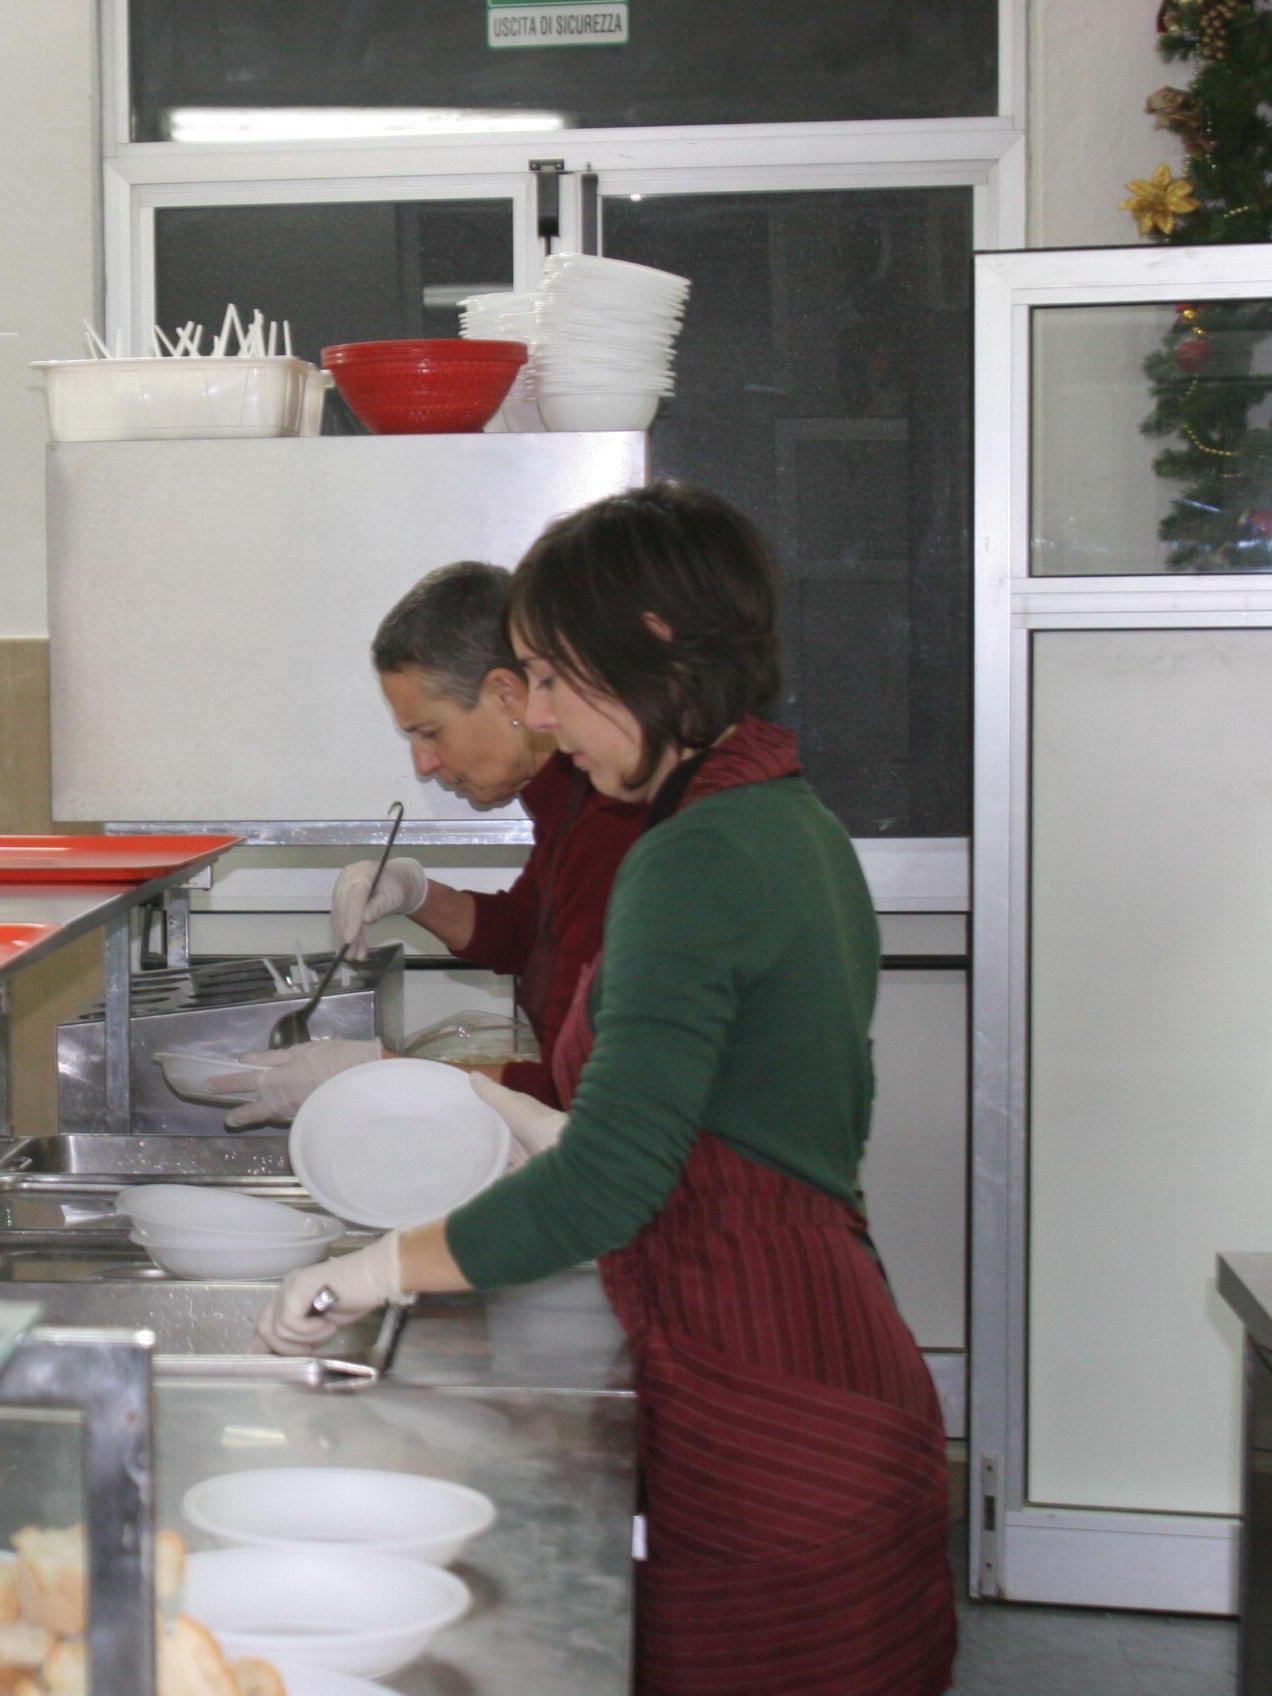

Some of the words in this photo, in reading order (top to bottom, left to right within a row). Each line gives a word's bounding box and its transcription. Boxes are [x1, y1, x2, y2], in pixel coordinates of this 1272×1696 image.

[493, 15, 537, 37] USCITA
[540, 15, 553, 35] DI
[556, 13, 622, 35] SICUREZZA
